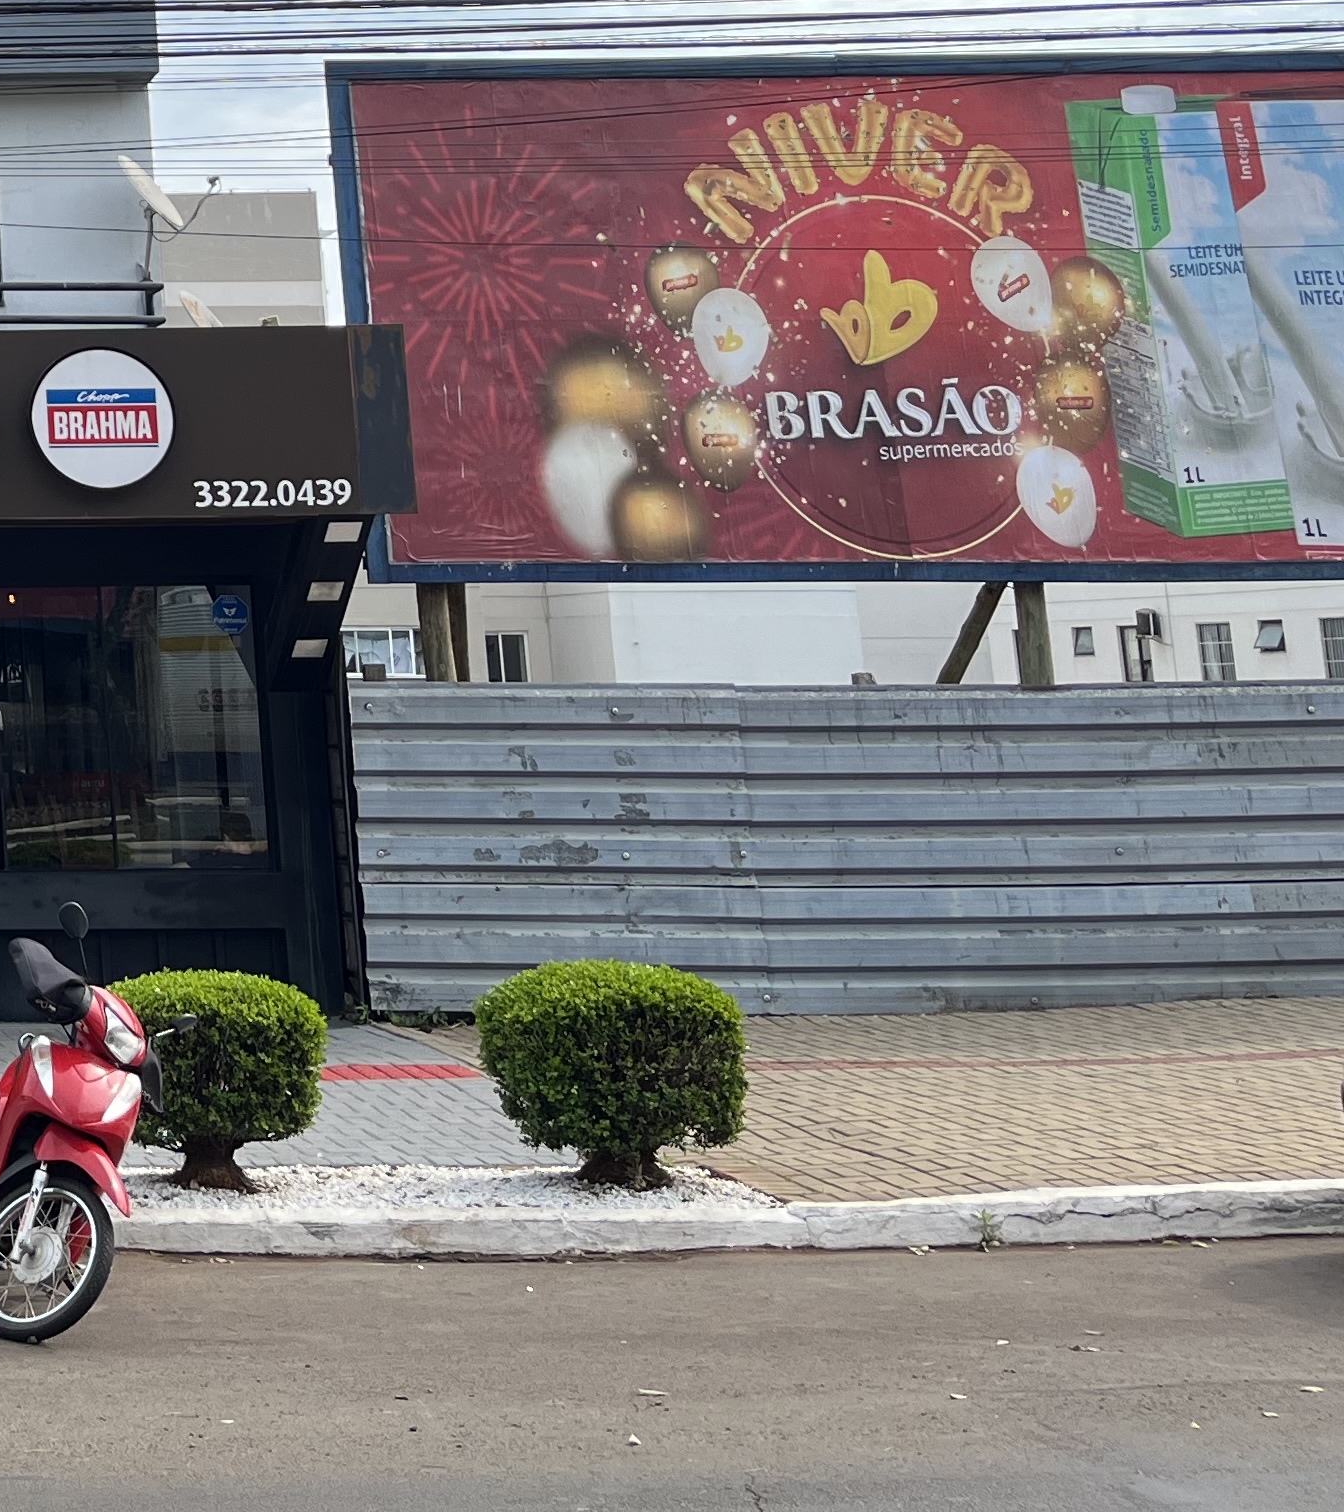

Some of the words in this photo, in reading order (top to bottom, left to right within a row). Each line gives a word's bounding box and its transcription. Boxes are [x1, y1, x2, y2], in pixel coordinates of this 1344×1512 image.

[1229, 115, 1253, 181] Integral
[683, 100, 1034, 245] NIVER
[1188, 245, 1222, 260] LEITE
[1294, 270, 1334, 286] LEITE
[1299, 289, 1344, 306] INTEG
[76, 390, 130, 403] Chopp
[765, 377, 1022, 439] BRASÃO
[53, 410, 153, 440] BRAHMA
[879, 439, 1025, 462] supermercados
[193, 478, 353, 508] 3322.0439
